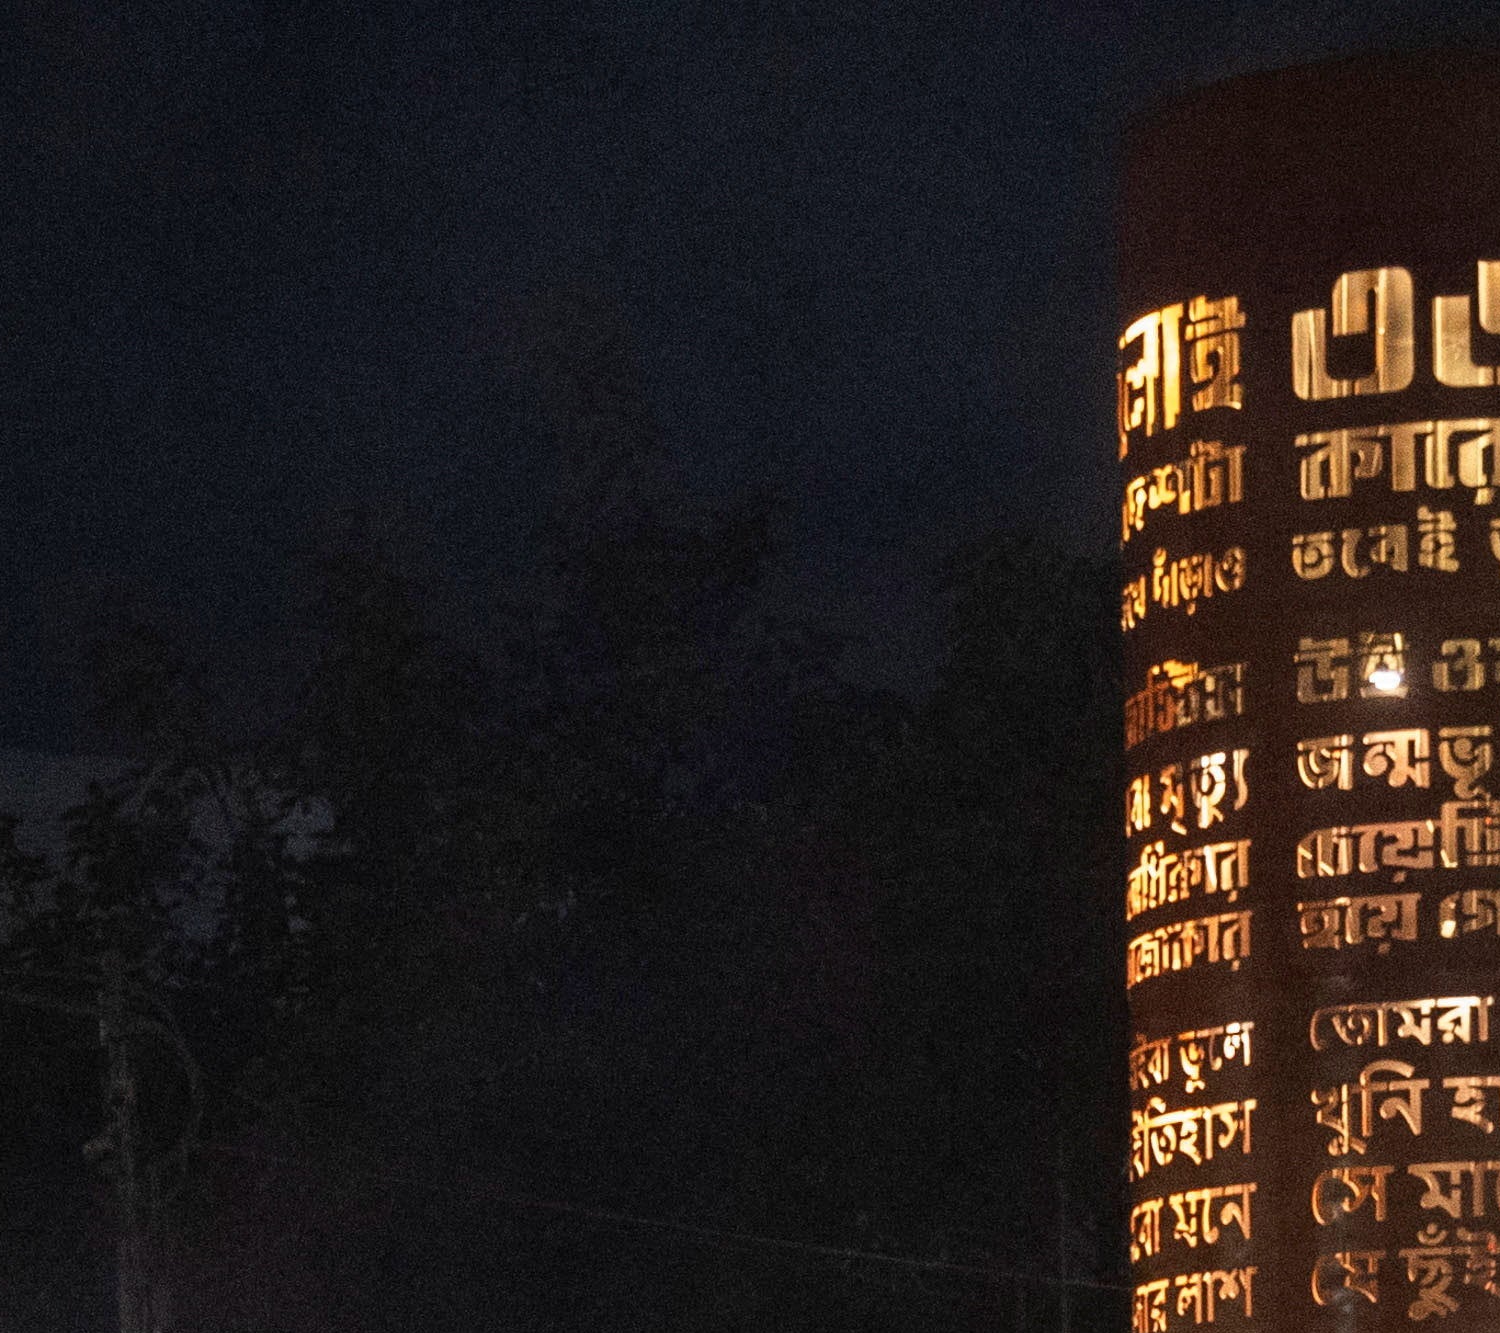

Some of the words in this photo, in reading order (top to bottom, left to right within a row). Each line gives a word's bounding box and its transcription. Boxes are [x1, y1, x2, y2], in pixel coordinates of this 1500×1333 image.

[1292, 508, 1457, 579] তবেই
[1294, 632, 1409, 703] উই
[1296, 891, 1420, 954] হয়ে
[1179, 1021, 1255, 1092] ভুলে
[1310, 997, 1491, 1053] তোমরা
[1310, 1059, 1432, 1157] খুনি
[1310, 1164, 1394, 1226] সে
[1176, 1264, 1256, 1322] লাশ
[1310, 1248, 1386, 1308] যে
